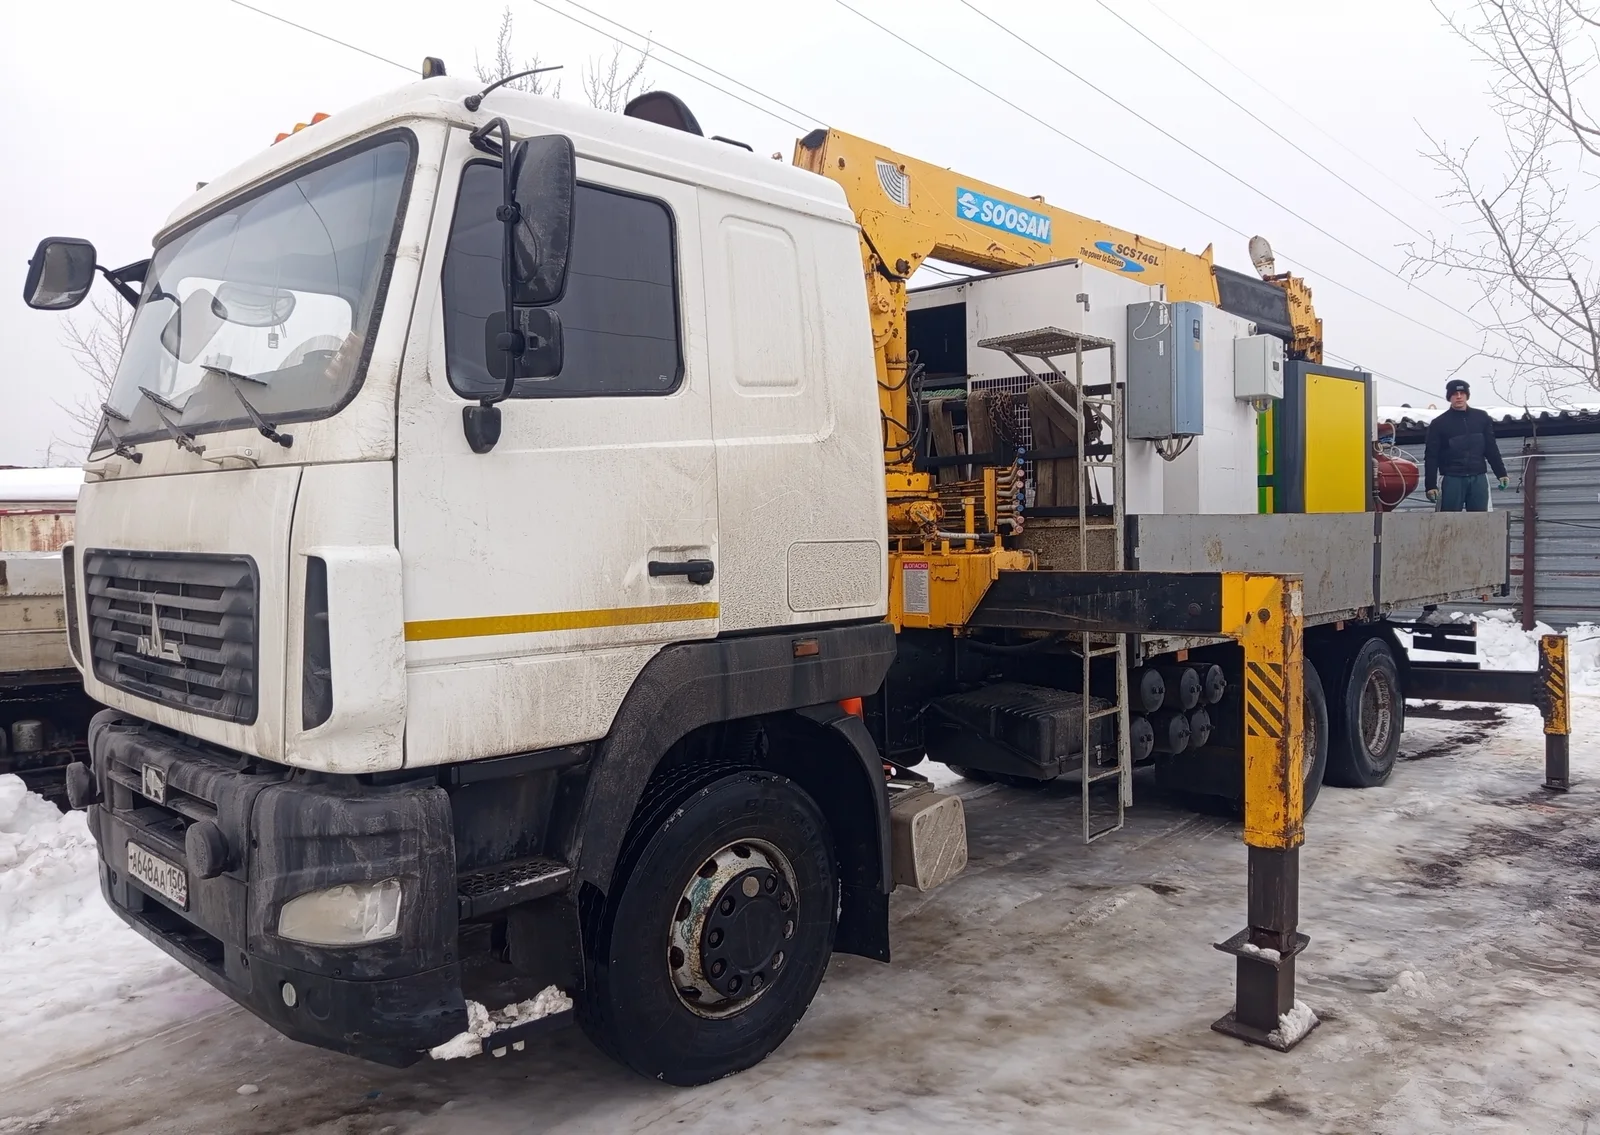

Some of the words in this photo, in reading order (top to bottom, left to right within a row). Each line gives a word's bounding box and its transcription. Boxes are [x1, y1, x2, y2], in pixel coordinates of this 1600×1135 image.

[981, 200, 1051, 240] SOOSAN
[1079, 246, 1088, 257] The
[1087, 250, 1102, 261] power
[1101, 253, 1107, 263] to
[1106, 254, 1124, 268] Success
[1116, 243, 1159, 267] SCS746L
[167, 867, 183, 892] 150
